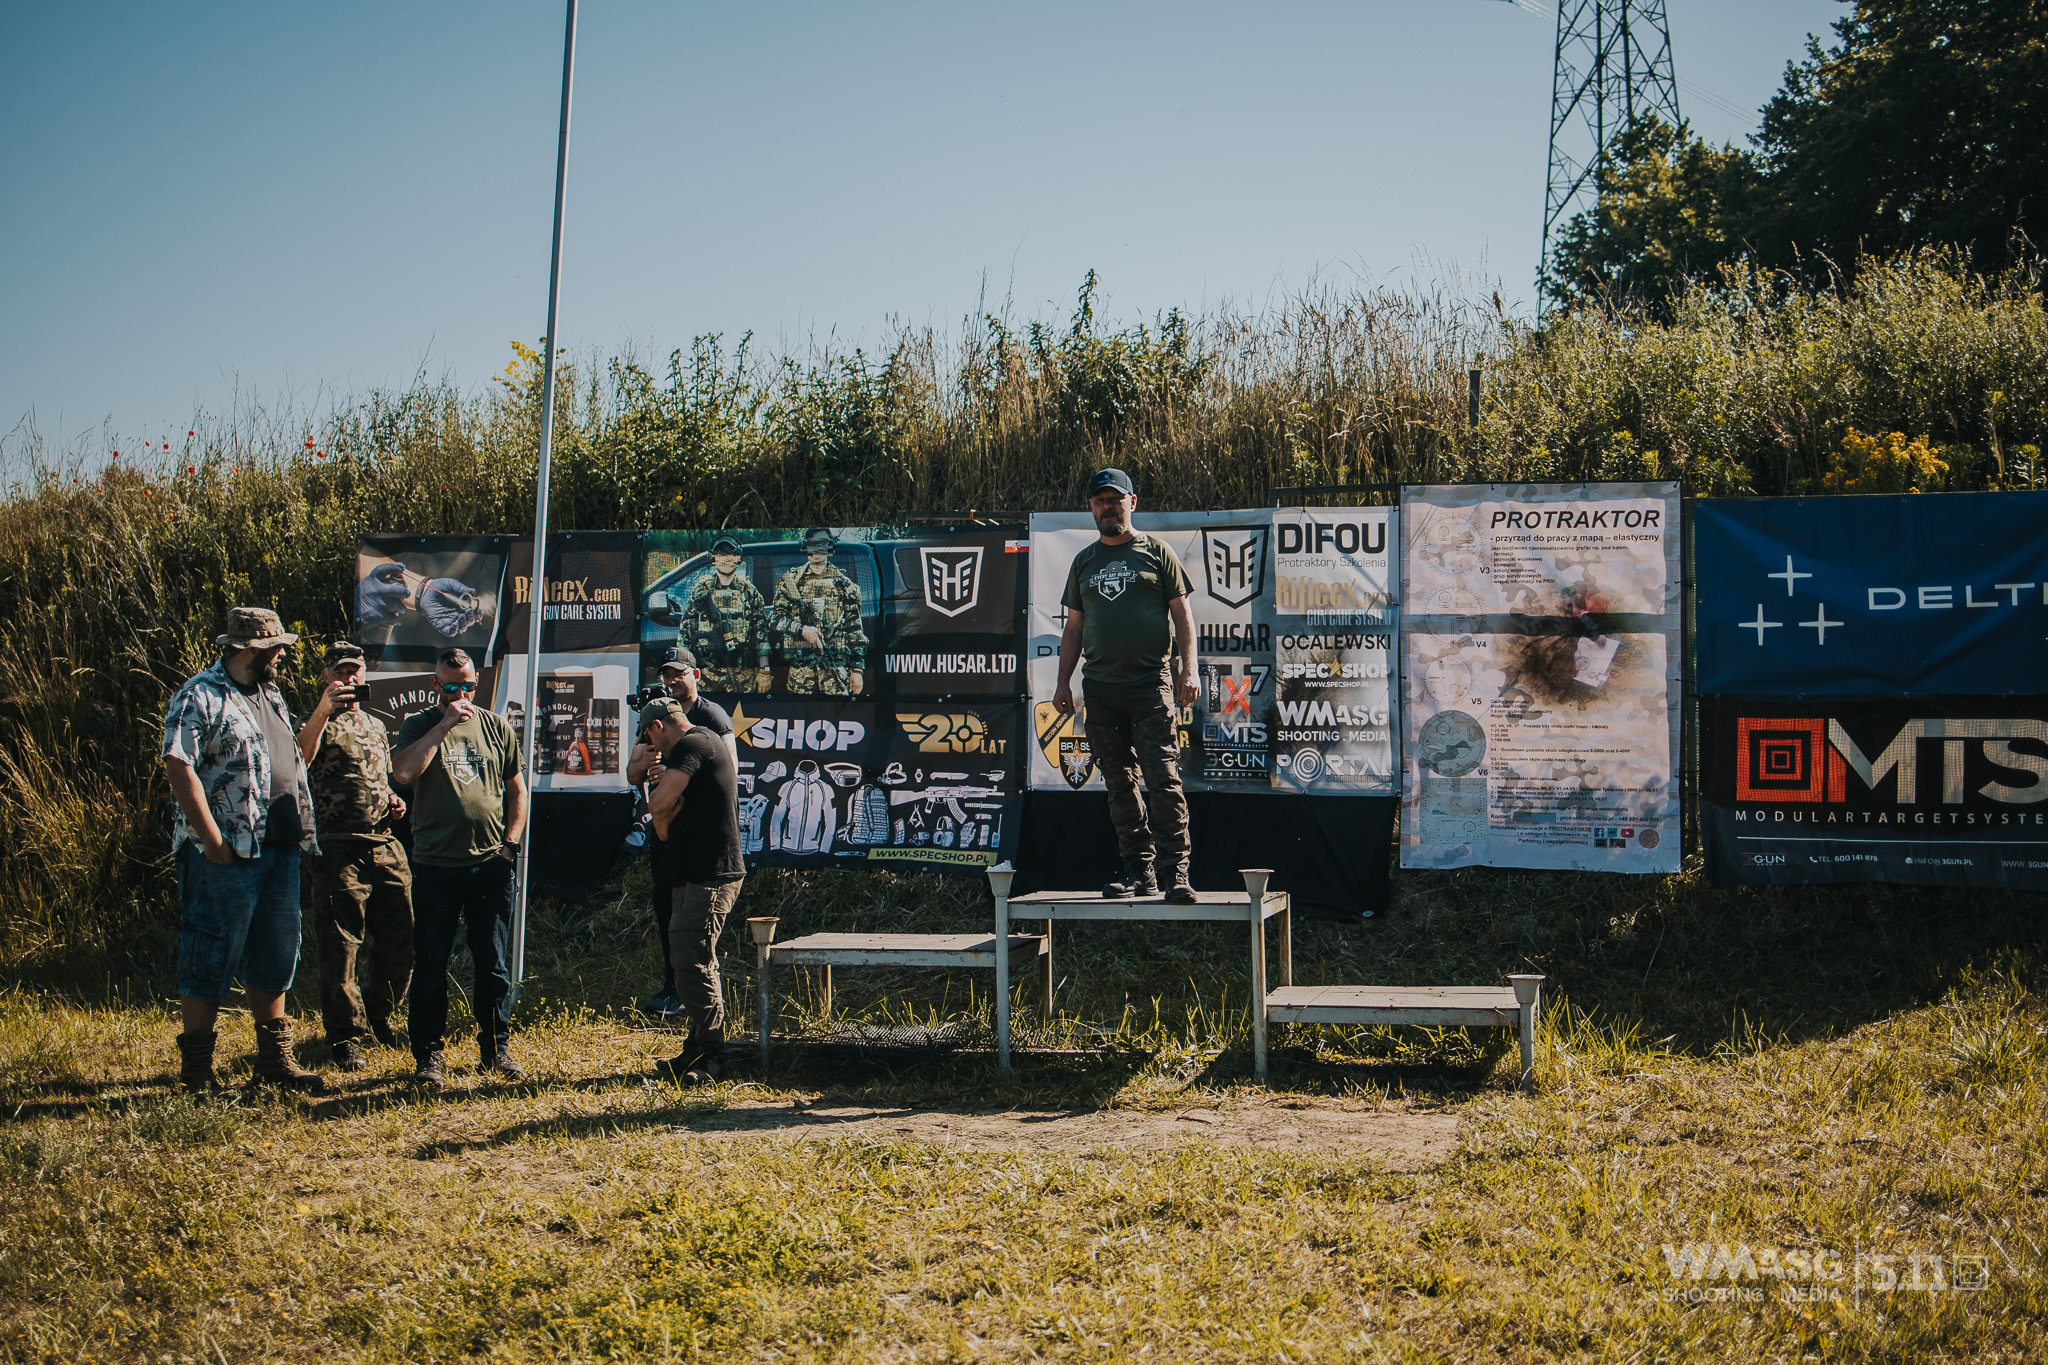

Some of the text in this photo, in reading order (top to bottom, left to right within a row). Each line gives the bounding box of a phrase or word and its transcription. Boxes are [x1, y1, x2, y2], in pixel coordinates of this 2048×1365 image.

[1490, 509, 1660, 529] PROTRAKTOR
[1278, 523, 1385, 554] DIFOU
[1495, 535, 1531, 544] przyrząd
[1547, 536, 1571, 544] pracy
[1580, 535, 1603, 543] mapą
[1613, 534, 1659, 543] elastyczny
[1277, 557, 1386, 569] Protraktory Szkolenia
[1868, 582, 2048, 610] DELT
[544, 604, 621, 621] GUN CARE SYSTEM
[1307, 609, 1391, 626] GUN CARE SYSTEM
[1200, 623, 1271, 652] HUSAR
[1281, 633, 1391, 650] OCALEWSKI
[885, 654, 1017, 673] WWW.HUSAR.LTD
[542, 703, 579, 714] HANDGUN
[1276, 700, 1388, 726] WMASG
[1043, 727, 1058, 742] RECON
[1221, 722, 1268, 743] MTS
[1277, 731, 1387, 741] SHOOTING MEDIA
[980, 739, 1007, 754] LAT
[876, 849, 989, 863] WWW.SPECSHOP.PL
